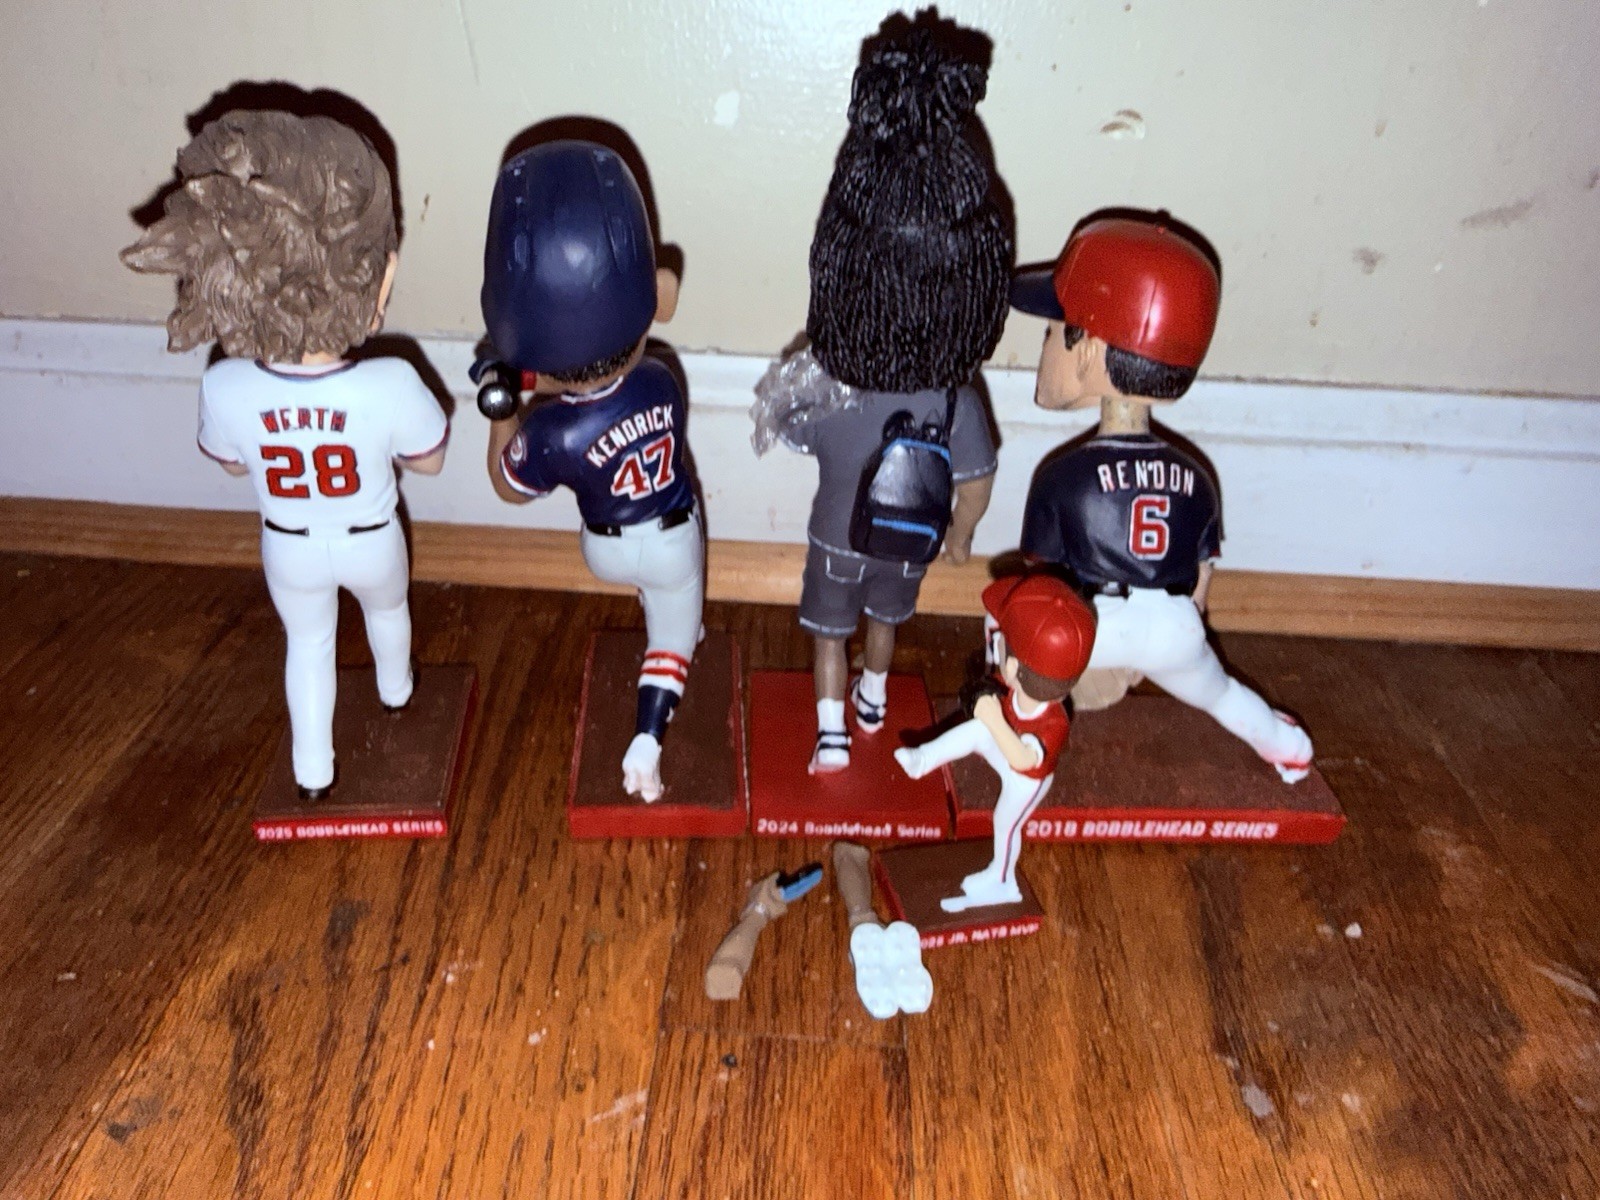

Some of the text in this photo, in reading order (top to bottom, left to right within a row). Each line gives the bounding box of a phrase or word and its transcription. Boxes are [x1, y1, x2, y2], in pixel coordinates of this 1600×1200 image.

[259, 407, 347, 433] WERTH
[587, 403, 674, 468] KENDRICK
[260, 444, 361, 499] 28
[610, 431, 675, 500] 47
[1097, 460, 1194, 497] RENDON
[1129, 494, 1170, 561] 6
[296, 822, 388, 838] BOBBLEHEAD
[392, 820, 443, 835] SERIES
[757, 818, 799, 834] 2024
[897, 824, 942, 839] Series
[1025, 820, 1279, 839] 2018 BOBBLEHEAD SERIES
